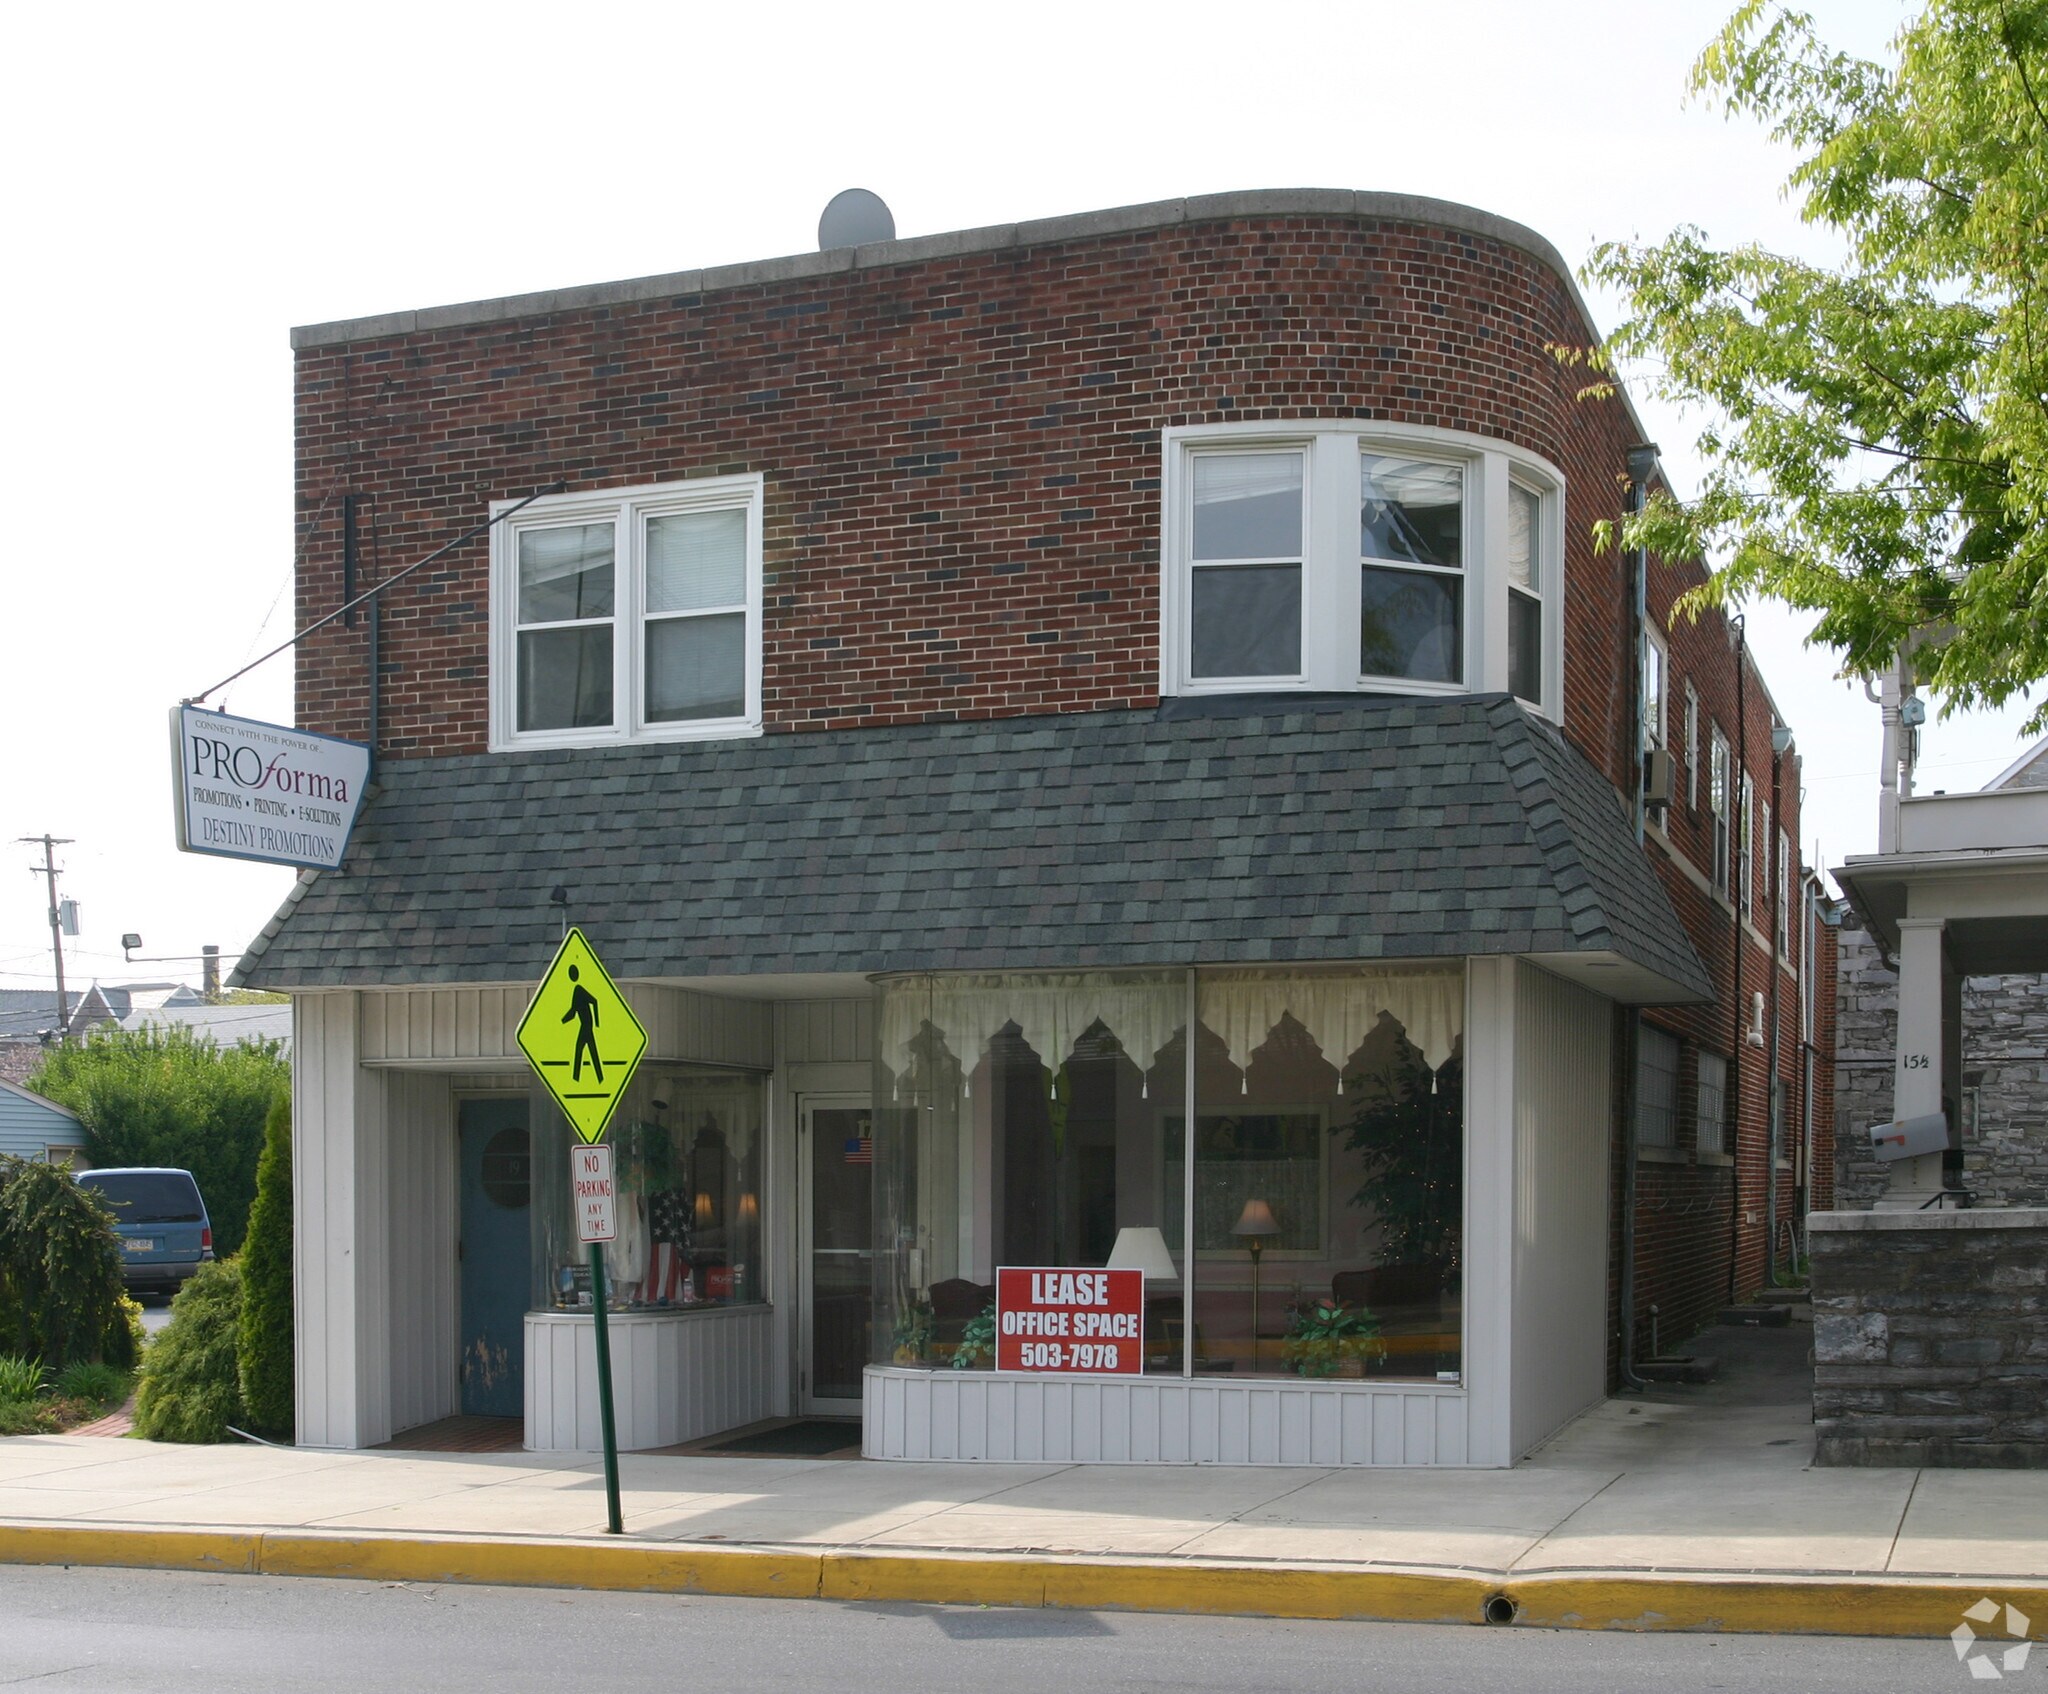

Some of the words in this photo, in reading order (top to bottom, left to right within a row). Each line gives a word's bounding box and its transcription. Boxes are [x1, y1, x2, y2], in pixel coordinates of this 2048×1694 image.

[195, 719, 235, 735] CONNECT
[237, 729, 260, 740] WITH
[263, 734, 278, 744] THE
[281, 738, 307, 750] POWER
[191, 735, 348, 803] PROforma
[193, 786, 242, 809] PROMOTIONS
[254, 797, 288, 818] PRINTING
[299, 805, 341, 827] E-SOLUTIONS
[203, 816, 256, 848] DESTINY
[260, 826, 334, 861] PROMOTIONS
[584, 1155, 599, 1172] NO
[577, 1180, 611, 1198] PARKING
[588, 1203, 603, 1215] ANY
[587, 1219, 606, 1232] TIME
[1031, 1273, 1109, 1306] LEASE
[1002, 1311, 1069, 1336] OFFICE
[1073, 1312, 1138, 1338] SPACE
[1020, 1342, 1118, 1369] 503-7978
